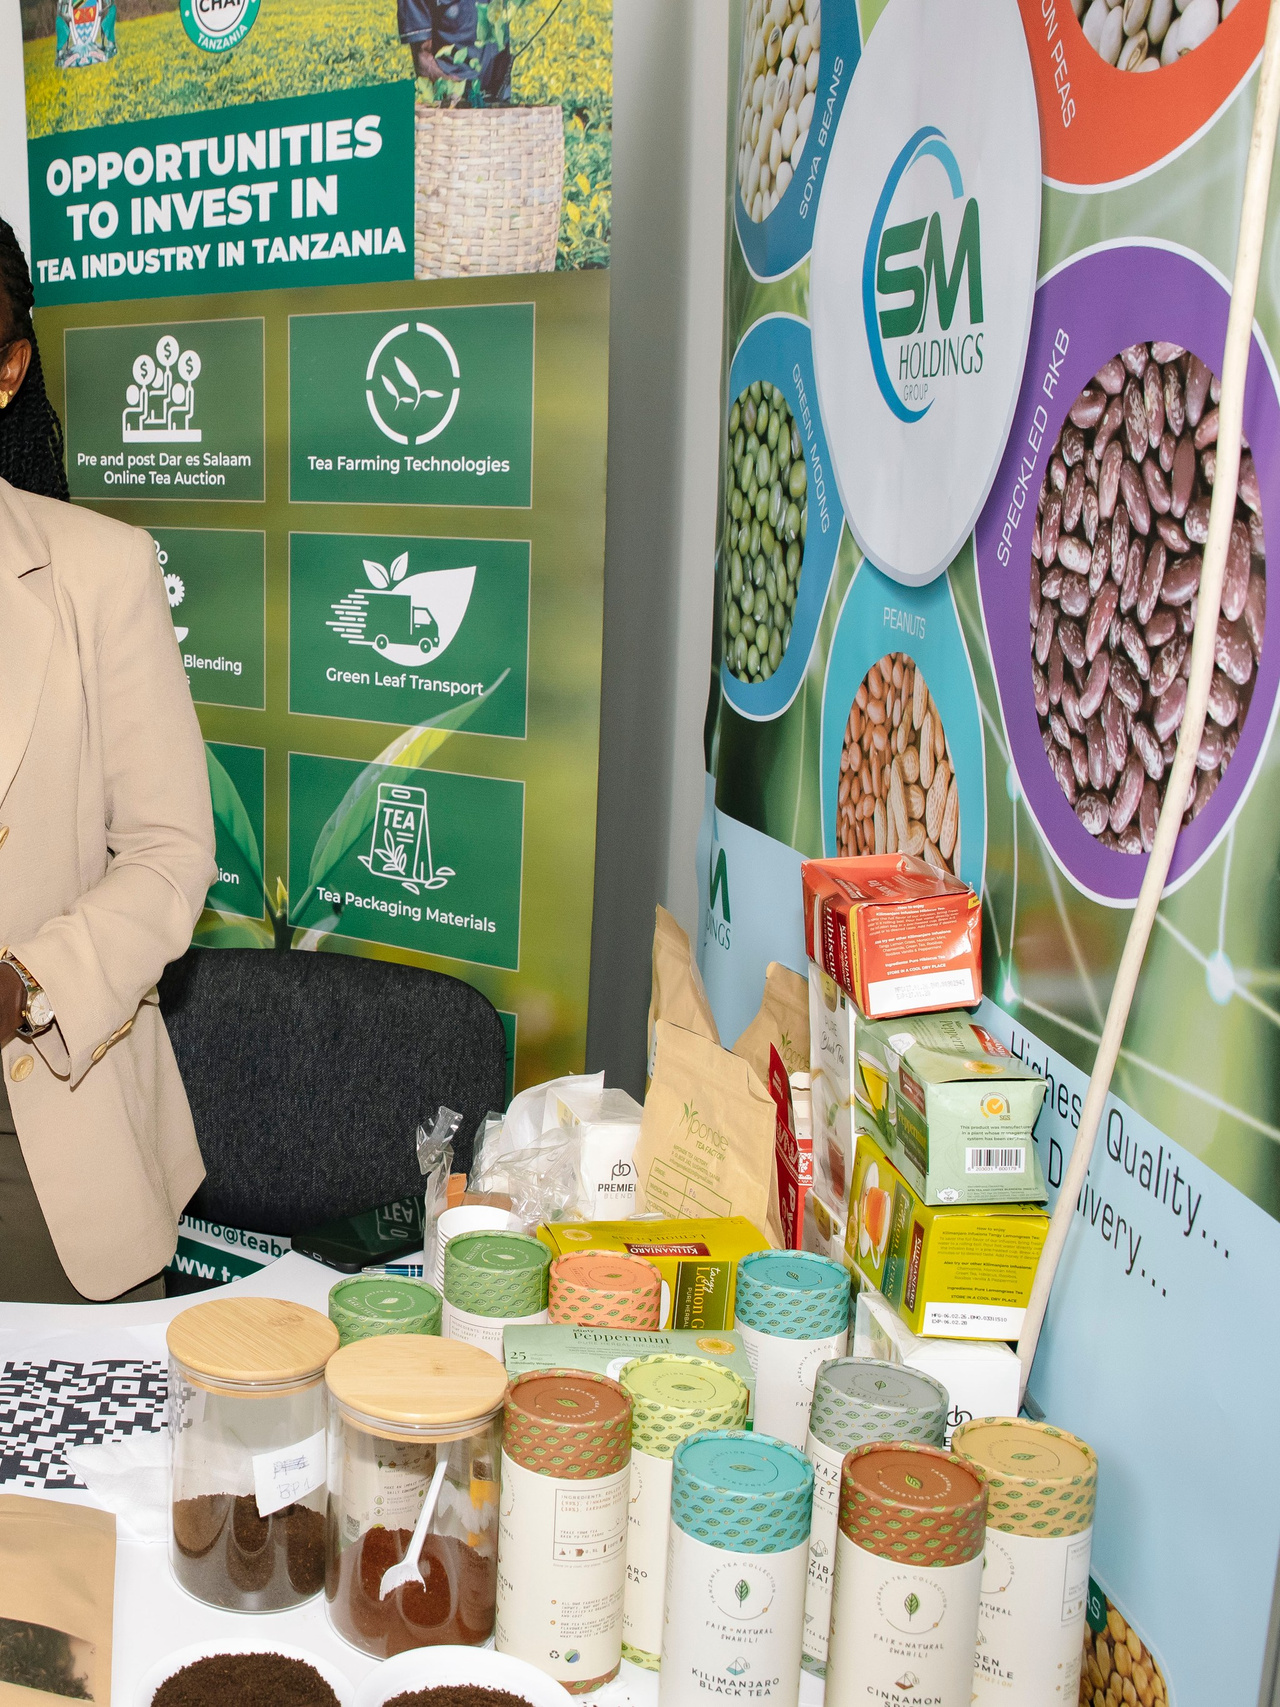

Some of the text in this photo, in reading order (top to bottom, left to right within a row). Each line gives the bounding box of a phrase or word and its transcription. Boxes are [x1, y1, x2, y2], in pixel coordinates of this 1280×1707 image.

[197, 24, 248, 50] TANZANIA
[1051, 42, 1077, 128] PEAS
[798, 56, 845, 220] SOYA BEANS
[46, 114, 383, 196] OPPORTUNITIES
[66, 174, 338, 241] TO INVEST IN
[37, 226, 406, 283] TEA INDUSTRY IN TANZANIA
[877, 197, 984, 339] SM
[899, 333, 985, 381] HOLDINGS
[903, 383, 930, 402] GROUP
[791, 363, 830, 535] GREEN MOONG
[997, 328, 1071, 567] SPECKLED RKB
[77, 452, 251, 469] Pre and post Dar es Salaam
[307, 455, 510, 476] Tea Farming Technologies
[104, 470, 226, 486] Online Tea Auction
[882, 607, 926, 641] PEANUTS
[184, 654, 242, 675] Blending
[326, 667, 484, 697] Green Leaf Transport
[383, 808, 415, 830] TEA
[317, 887, 496, 933] Tea Packaging Materials
[695, 1141, 726, 1162] TEA FACTORY
[630, 1247, 698, 1255] KILIMANJARO
[704, 1267, 721, 1294] tangy
[909, 1237, 922, 1309] KILIMANJARO
[692, 1266, 710, 1315] Lemon
[572, 1332, 672, 1345] Peppermint
[510, 1352, 527, 1361] 25
[815, 1463, 838, 1482] KAZ
[708, 1568, 721, 1604] TANZANIA
[743, 1562, 776, 1593] COLLECTION
[705, 1621, 774, 1635] FAIR NATURAL
[721, 1633, 758, 1644] SWAHILI
[873, 1633, 944, 1650] FAIR NATURAL
[889, 1647, 928, 1659] SWAHILI
[691, 1667, 780, 1688] KILIMANJARO
[699, 1679, 771, 1697] BLACK TEA
[866, 1686, 942, 1705] CINNAMON
